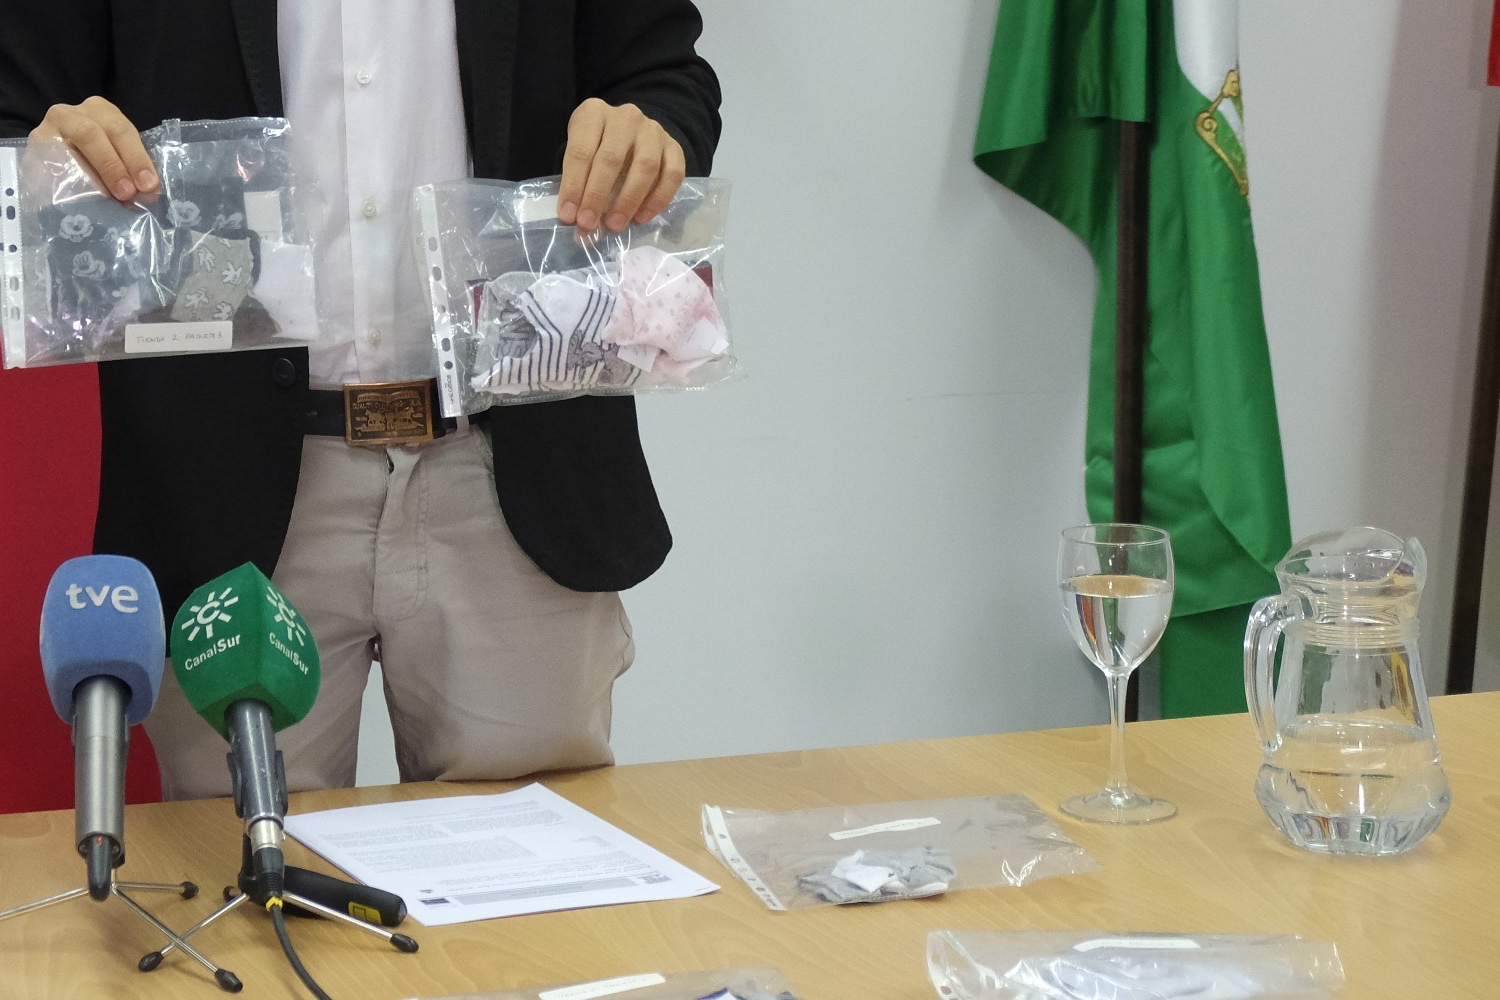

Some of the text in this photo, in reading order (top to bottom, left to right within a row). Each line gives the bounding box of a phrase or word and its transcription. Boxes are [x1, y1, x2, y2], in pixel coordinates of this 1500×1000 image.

[65, 583, 139, 614] tve
[184, 634, 242, 672] CanalSur
[269, 632, 309, 676] CanalSur
